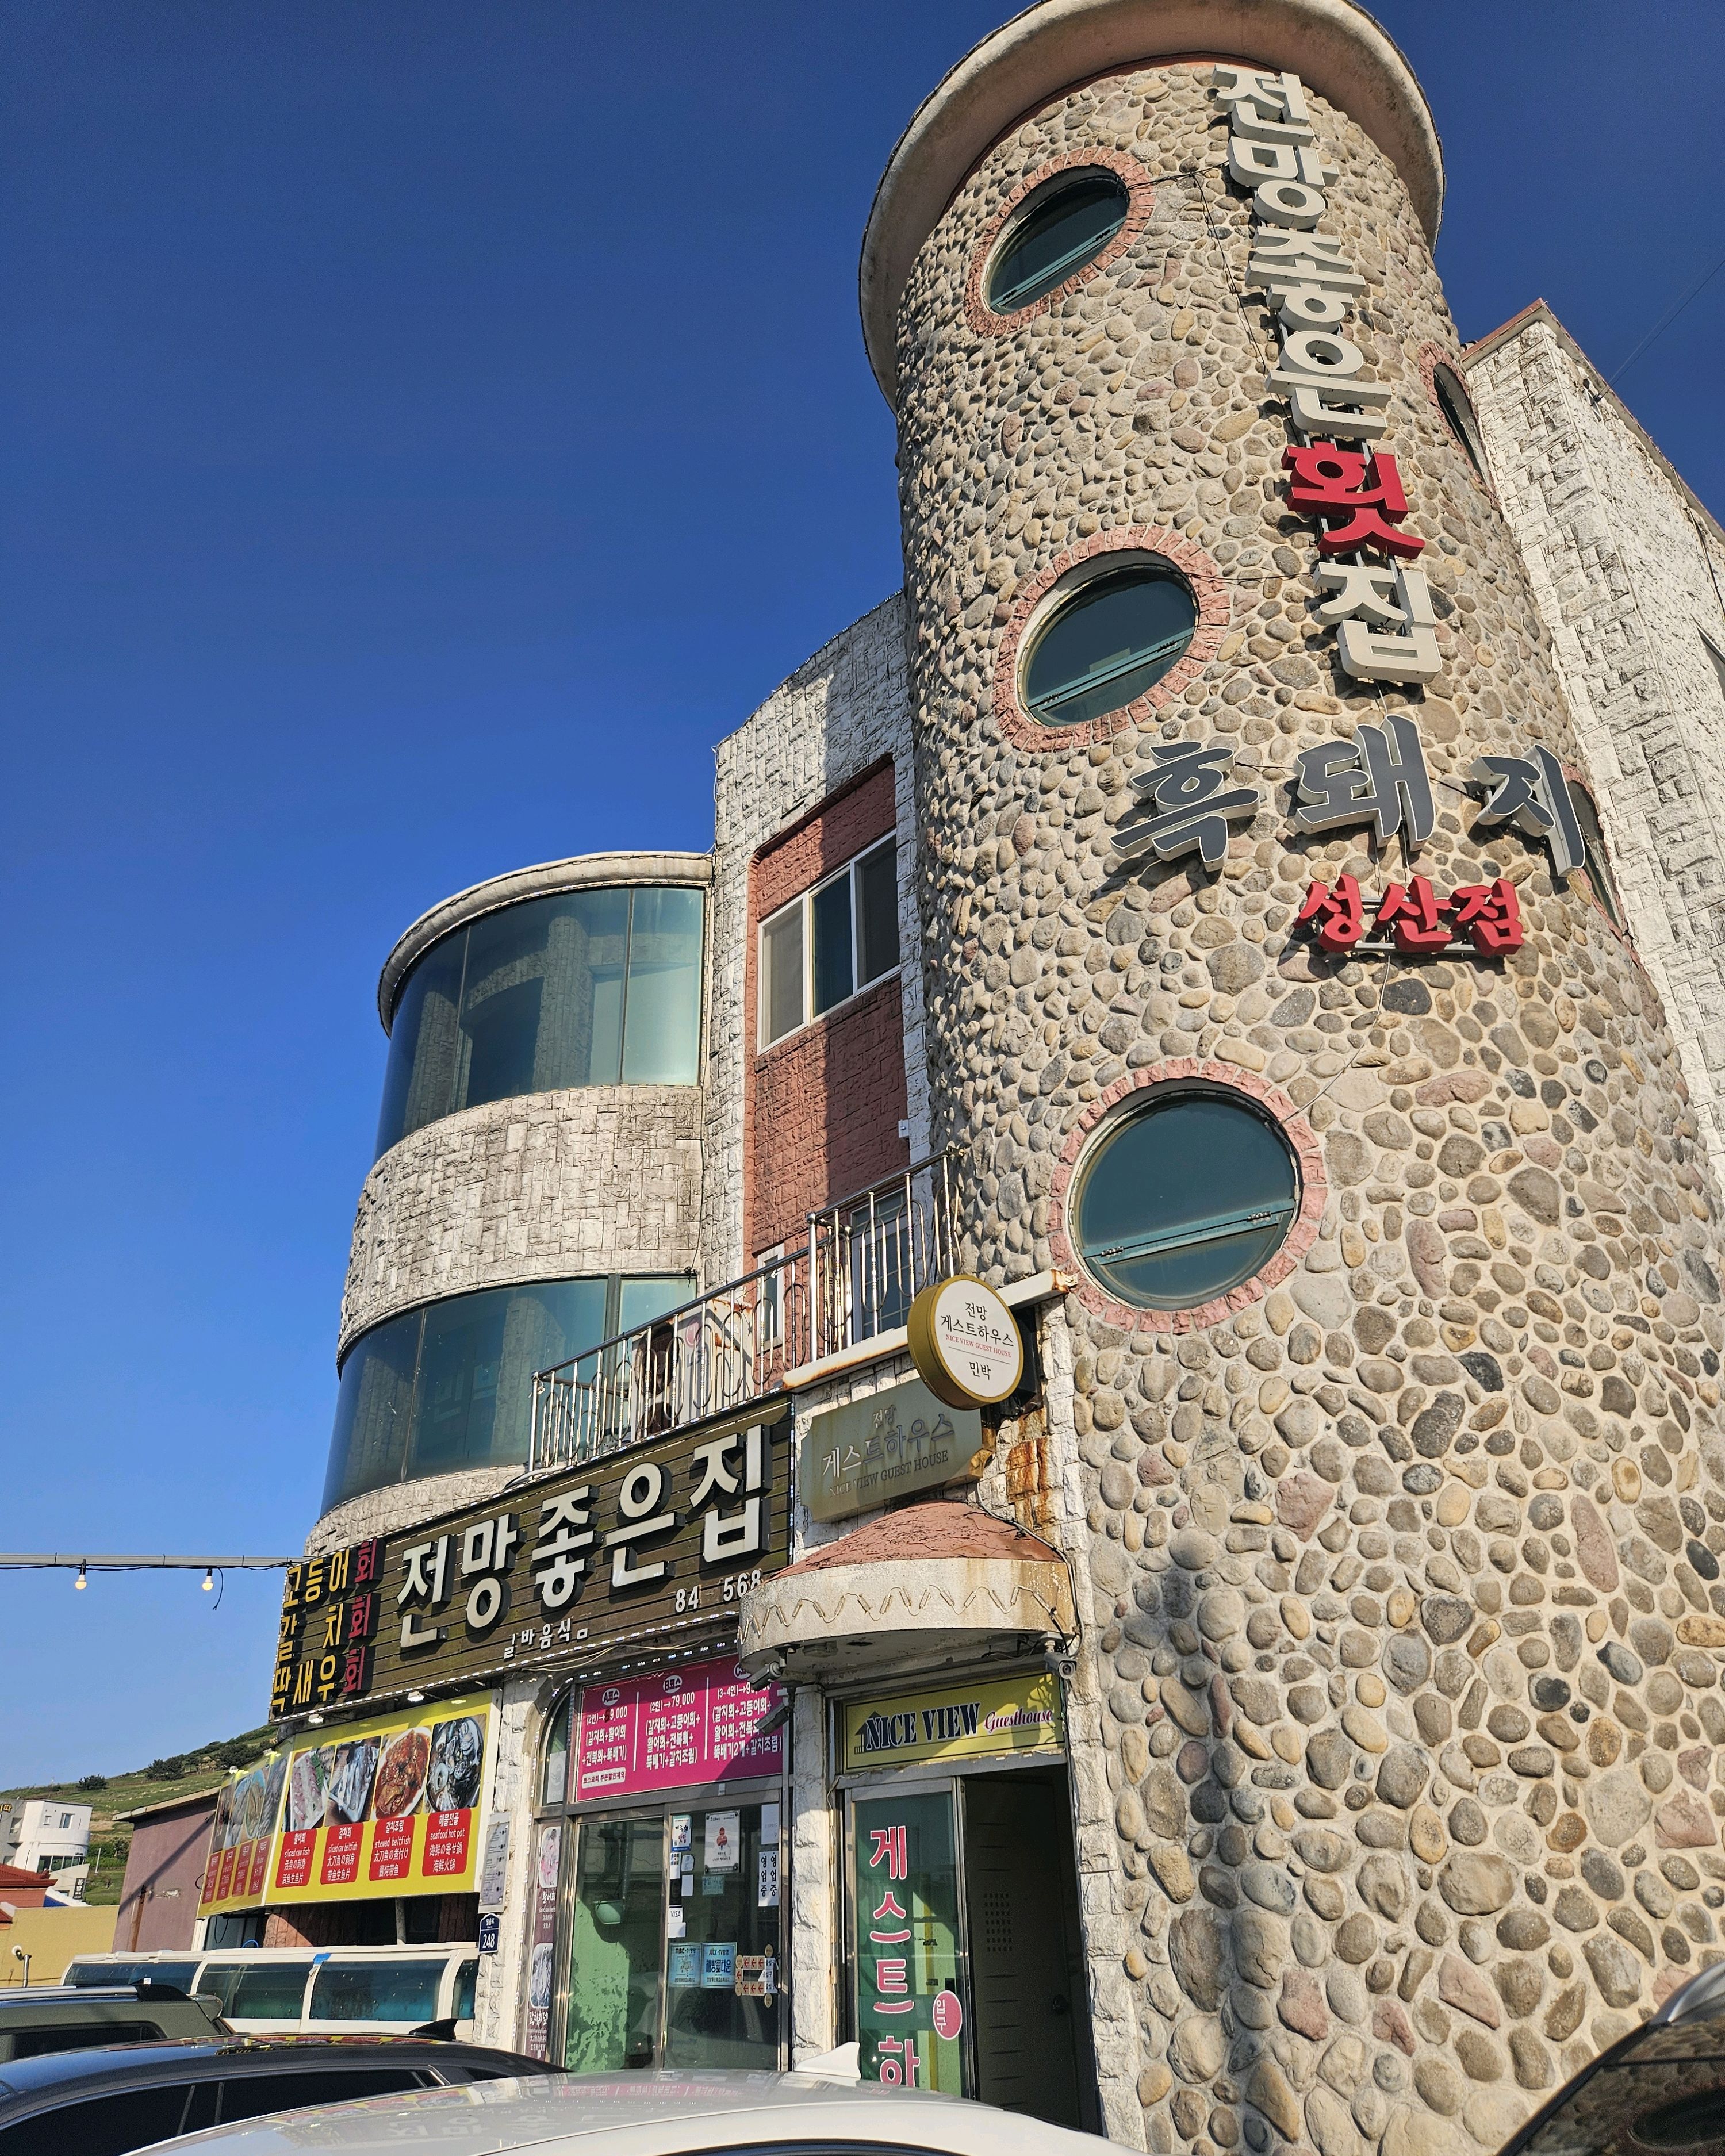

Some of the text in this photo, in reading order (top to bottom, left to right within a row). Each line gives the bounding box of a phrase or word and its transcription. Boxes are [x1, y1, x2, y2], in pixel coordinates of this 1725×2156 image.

[1212, 64, 1443, 683] 전망좋은횟집
[1109, 715, 1585, 878] 흑돼지
[1294, 873, 1524, 957] 성산점
[964, 1302, 987, 1321] 전망
[941, 1314, 1014, 1347] 게스트하우스
[946, 1334, 1011, 1357] NICE VIEW GUEST HOUSE
[969, 1361, 991, 1380] 민박
[872, 1404, 897, 1428] 전망
[822, 1413, 955, 1478] 게스트하우스
[829, 1450, 949, 1498] NICE VIEW GUEST HOUSE
[397, 1423, 766, 1648] 전망좋은집
[865, 1702, 1053, 1751] NICE VIEW Guesthouse
[430, 1828, 465, 1840] seafood hot pot
[482, 1932, 495, 1949] 248
[936, 1999, 947, 2031] 입구
